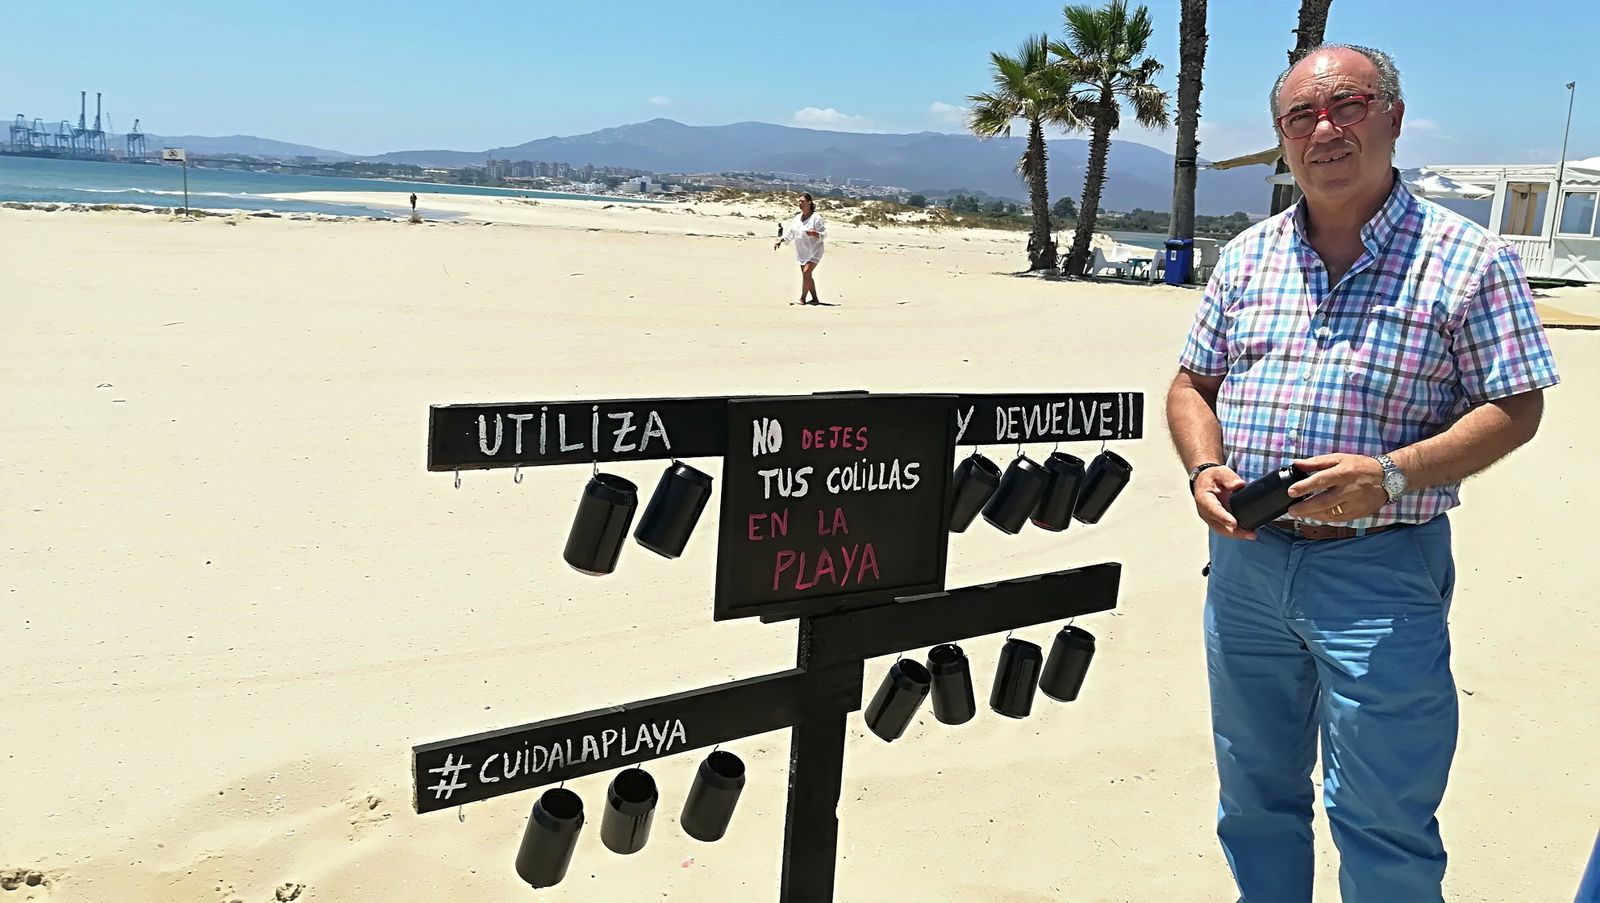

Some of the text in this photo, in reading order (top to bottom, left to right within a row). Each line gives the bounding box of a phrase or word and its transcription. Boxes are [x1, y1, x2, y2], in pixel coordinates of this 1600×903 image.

[752, 417, 869, 457] NO DEJES
[955, 393, 1134, 442] Y DEVUELVE!!
[758, 466, 814, 499] TUS
[747, 507, 849, 541] EN LA
[773, 543, 880, 591] PLAYA
